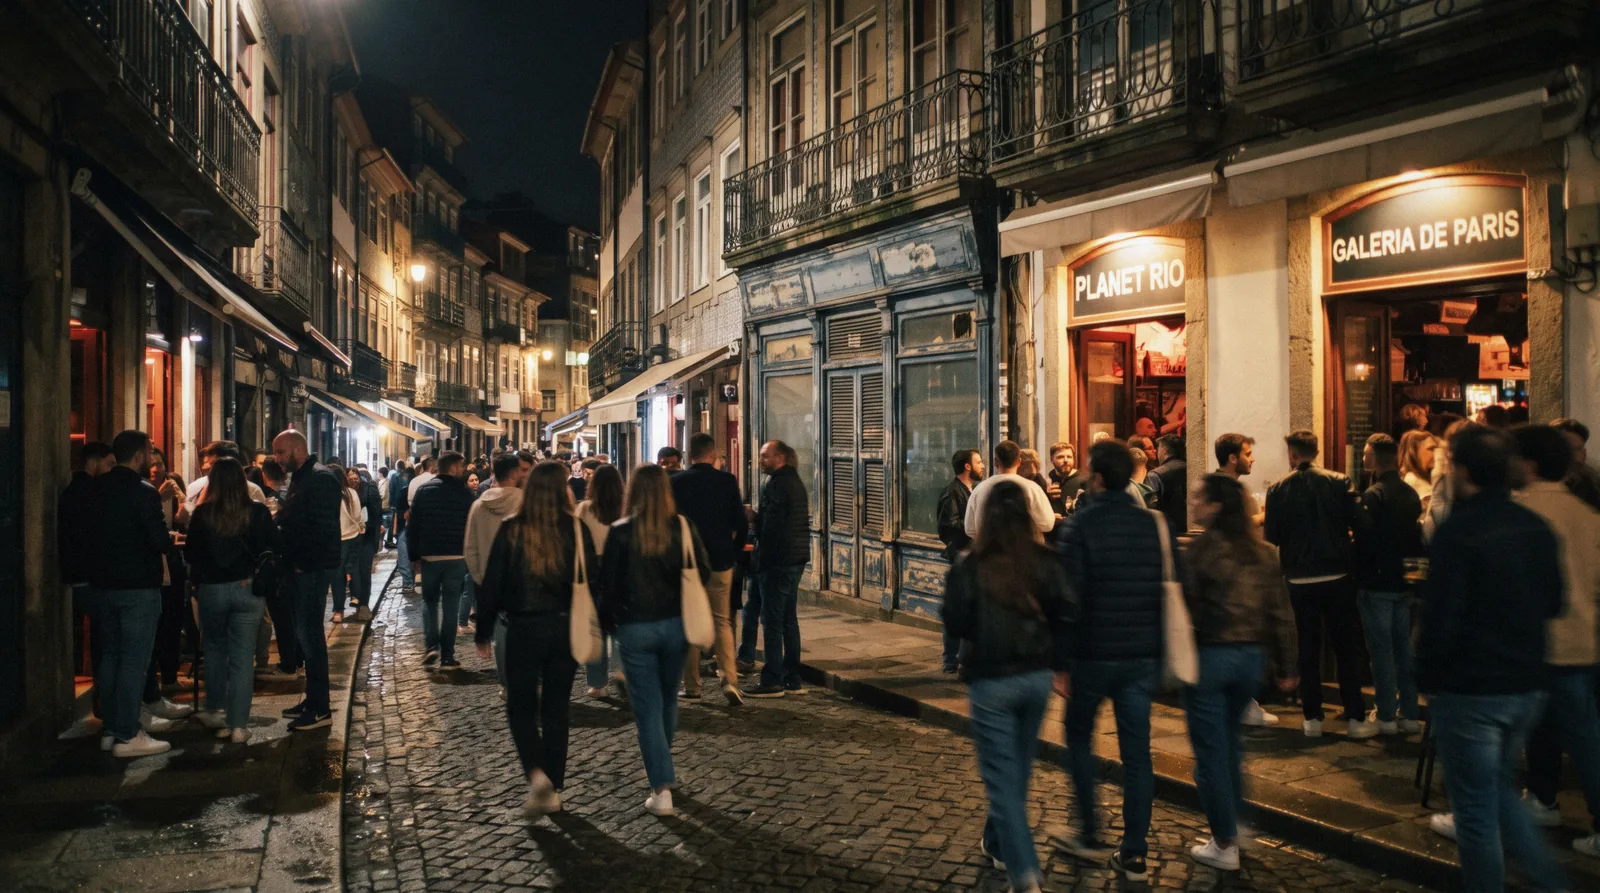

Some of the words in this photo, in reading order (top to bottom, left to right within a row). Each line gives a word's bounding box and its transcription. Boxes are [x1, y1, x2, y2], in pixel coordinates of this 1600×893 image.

[1333, 227, 1416, 262] GALERIA
[1420, 221, 1448, 250] DE
[1454, 210, 1520, 245] PARIS
[1075, 265, 1145, 301] PLANET
[1149, 259, 1185, 291] RIO
